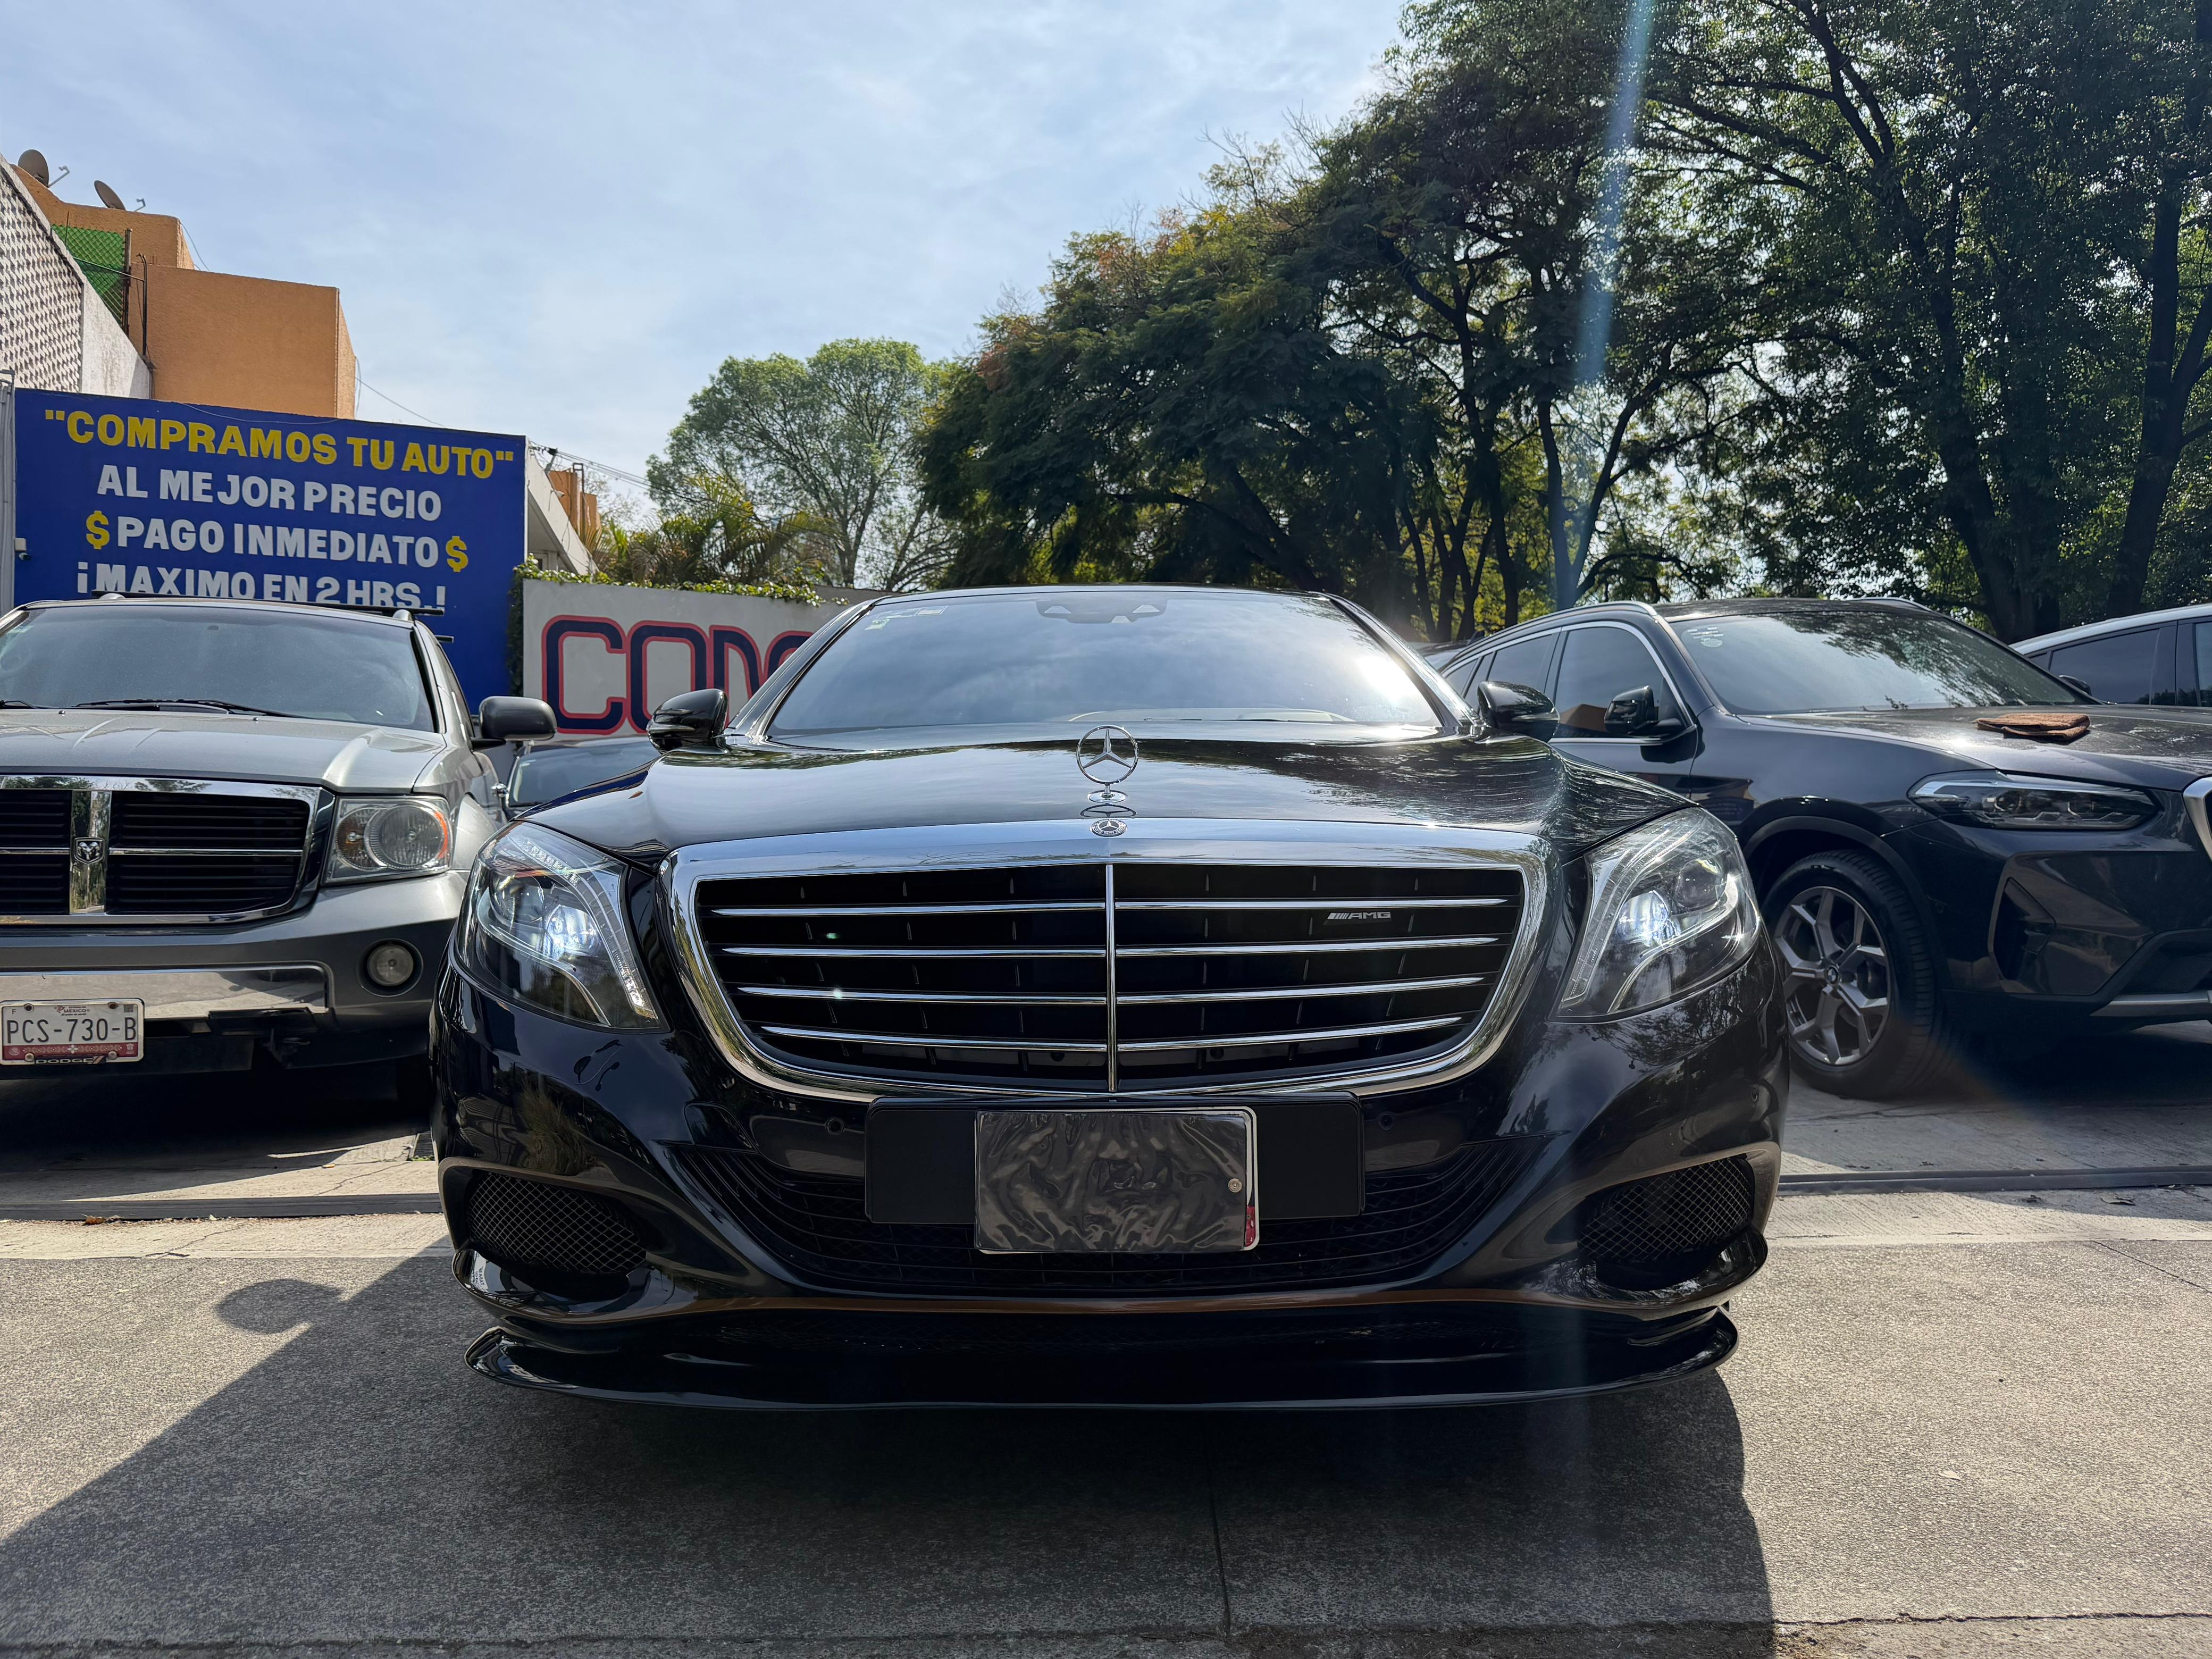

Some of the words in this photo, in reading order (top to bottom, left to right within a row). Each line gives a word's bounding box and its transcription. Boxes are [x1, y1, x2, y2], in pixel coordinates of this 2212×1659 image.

[45, 409, 337, 466] "COMPRAMOS
[347, 437, 394, 470] TU
[402, 442, 514, 479] AUTO"
[97, 464, 148, 498] AL
[160, 469, 295, 510] MEJOR
[304, 481, 442, 522] PRECIO
[86, 510, 110, 550] $
[118, 516, 224, 554] PAGO
[233, 523, 438, 568] INMEDIATO
[445, 535, 469, 573] $
[77, 562, 257, 600] ¡MAXIMO
[263, 574, 308, 602] EN
[315, 576, 341, 604] 2
[7, 1017, 136, 1043] PCS-730-B
